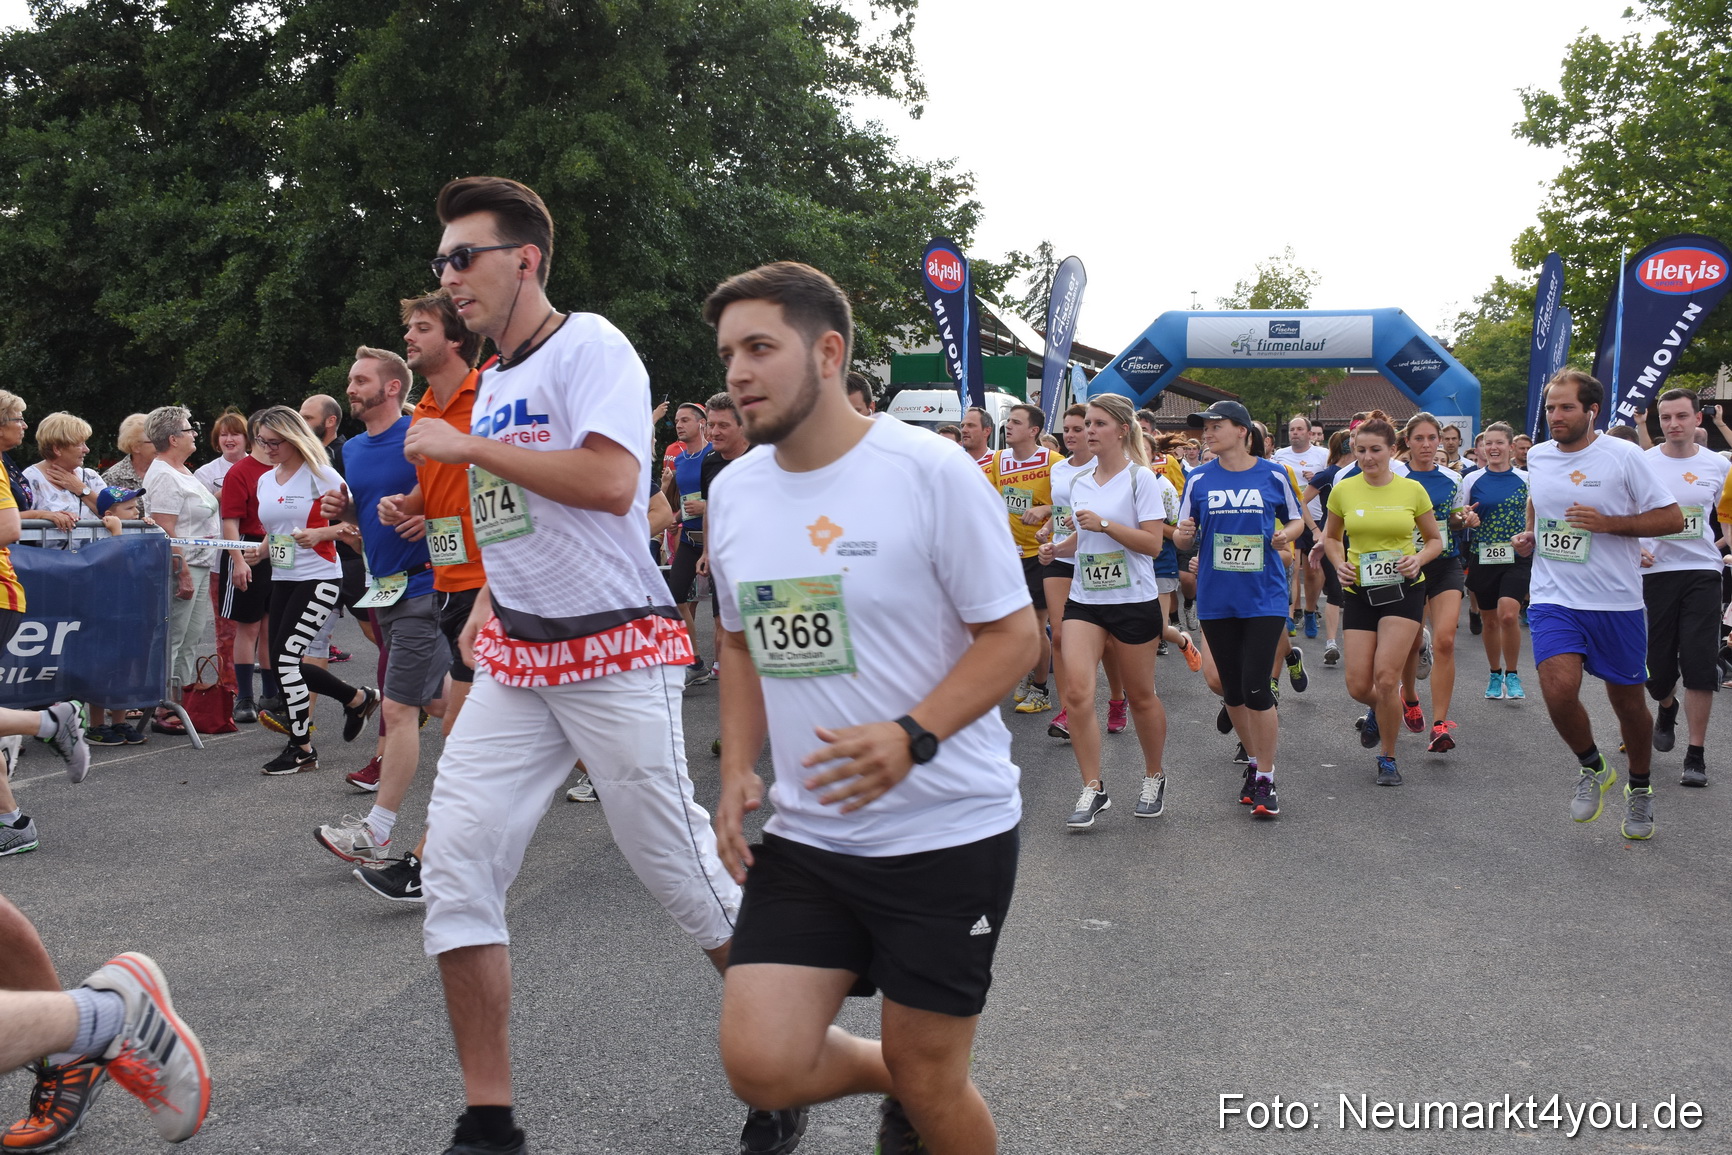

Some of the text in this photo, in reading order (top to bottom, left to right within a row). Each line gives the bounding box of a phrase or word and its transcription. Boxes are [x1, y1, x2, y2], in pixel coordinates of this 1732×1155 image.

[1646, 258, 1720, 284] Hervis
[1057, 272, 1076, 335] Fischer
[1257, 338, 1327, 351] firmenlauf
[1128, 361, 1164, 370] Fischer
[999, 470, 1050, 486] MAX BÖGL
[1005, 495, 1027, 508] 1701
[1208, 489, 1264, 509] DVA
[429, 534, 458, 553] 1805
[1542, 532, 1583, 551] 1367
[270, 546, 286, 560] 375
[1223, 547, 1252, 561] 677
[1486, 547, 1506, 558] 268
[1085, 564, 1122, 580] 1474
[1366, 562, 1399, 576] 1265
[754, 612, 834, 650] 1368
[583, 622, 654, 661] AVIA
[278, 581, 340, 737] ORIGINALS
[515, 641, 575, 668] AVIA
[786, 651, 825, 660] Christian
